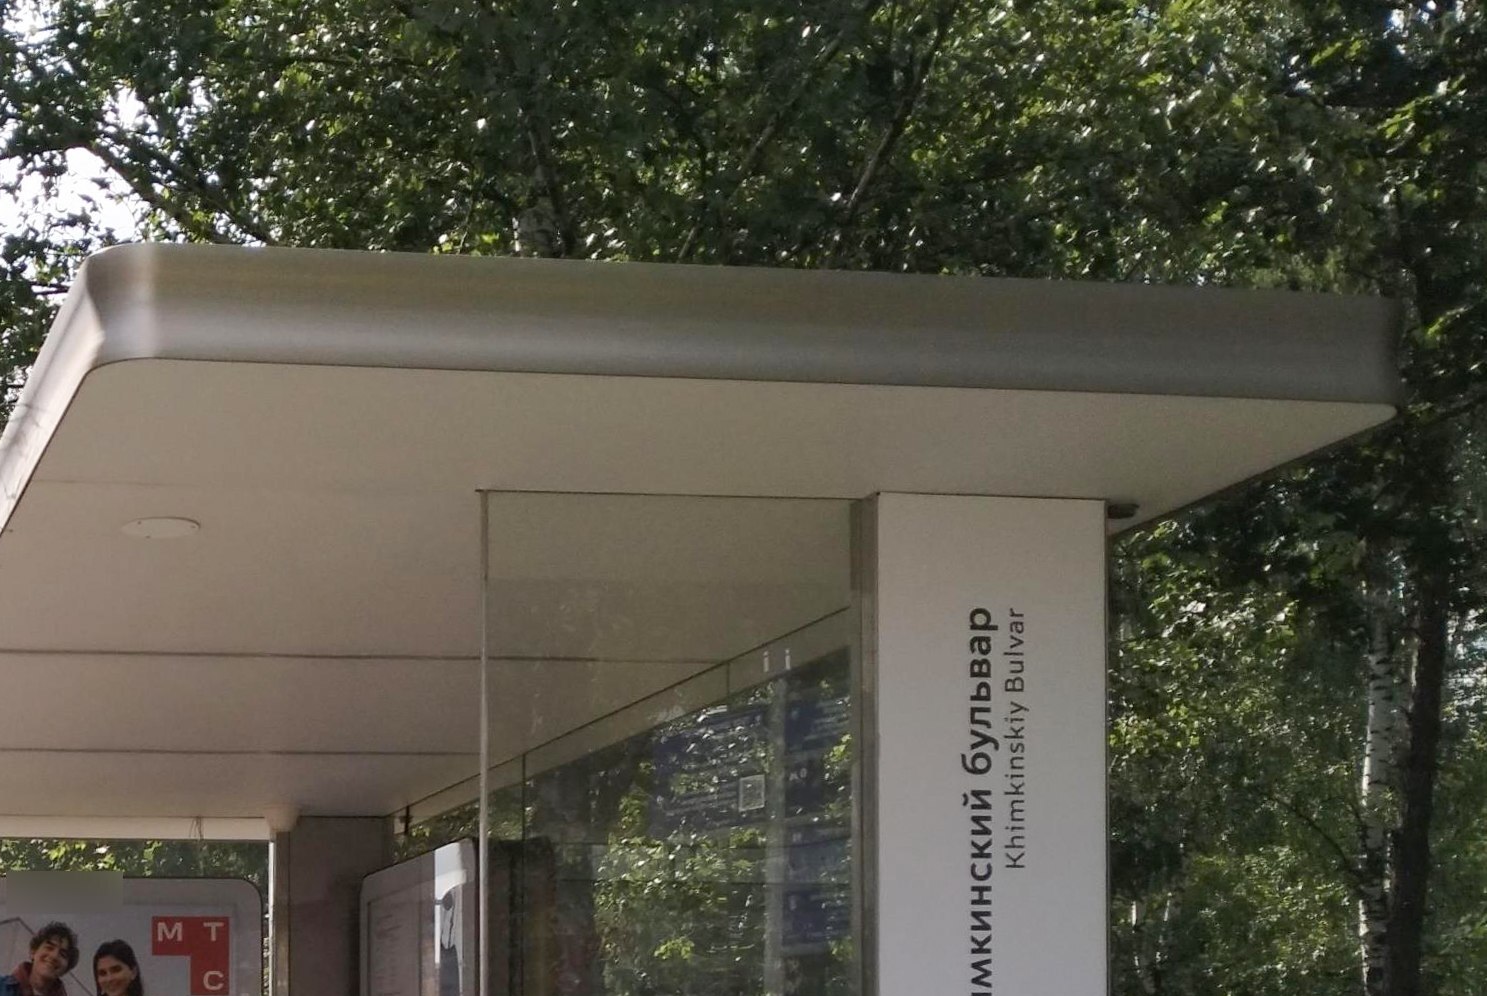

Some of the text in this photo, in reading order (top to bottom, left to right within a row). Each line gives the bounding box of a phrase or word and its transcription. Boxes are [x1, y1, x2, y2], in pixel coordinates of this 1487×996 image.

[961, 607, 999, 775] бульвар
[1003, 608, 1029, 869] Khimkinskiy Bulvar
